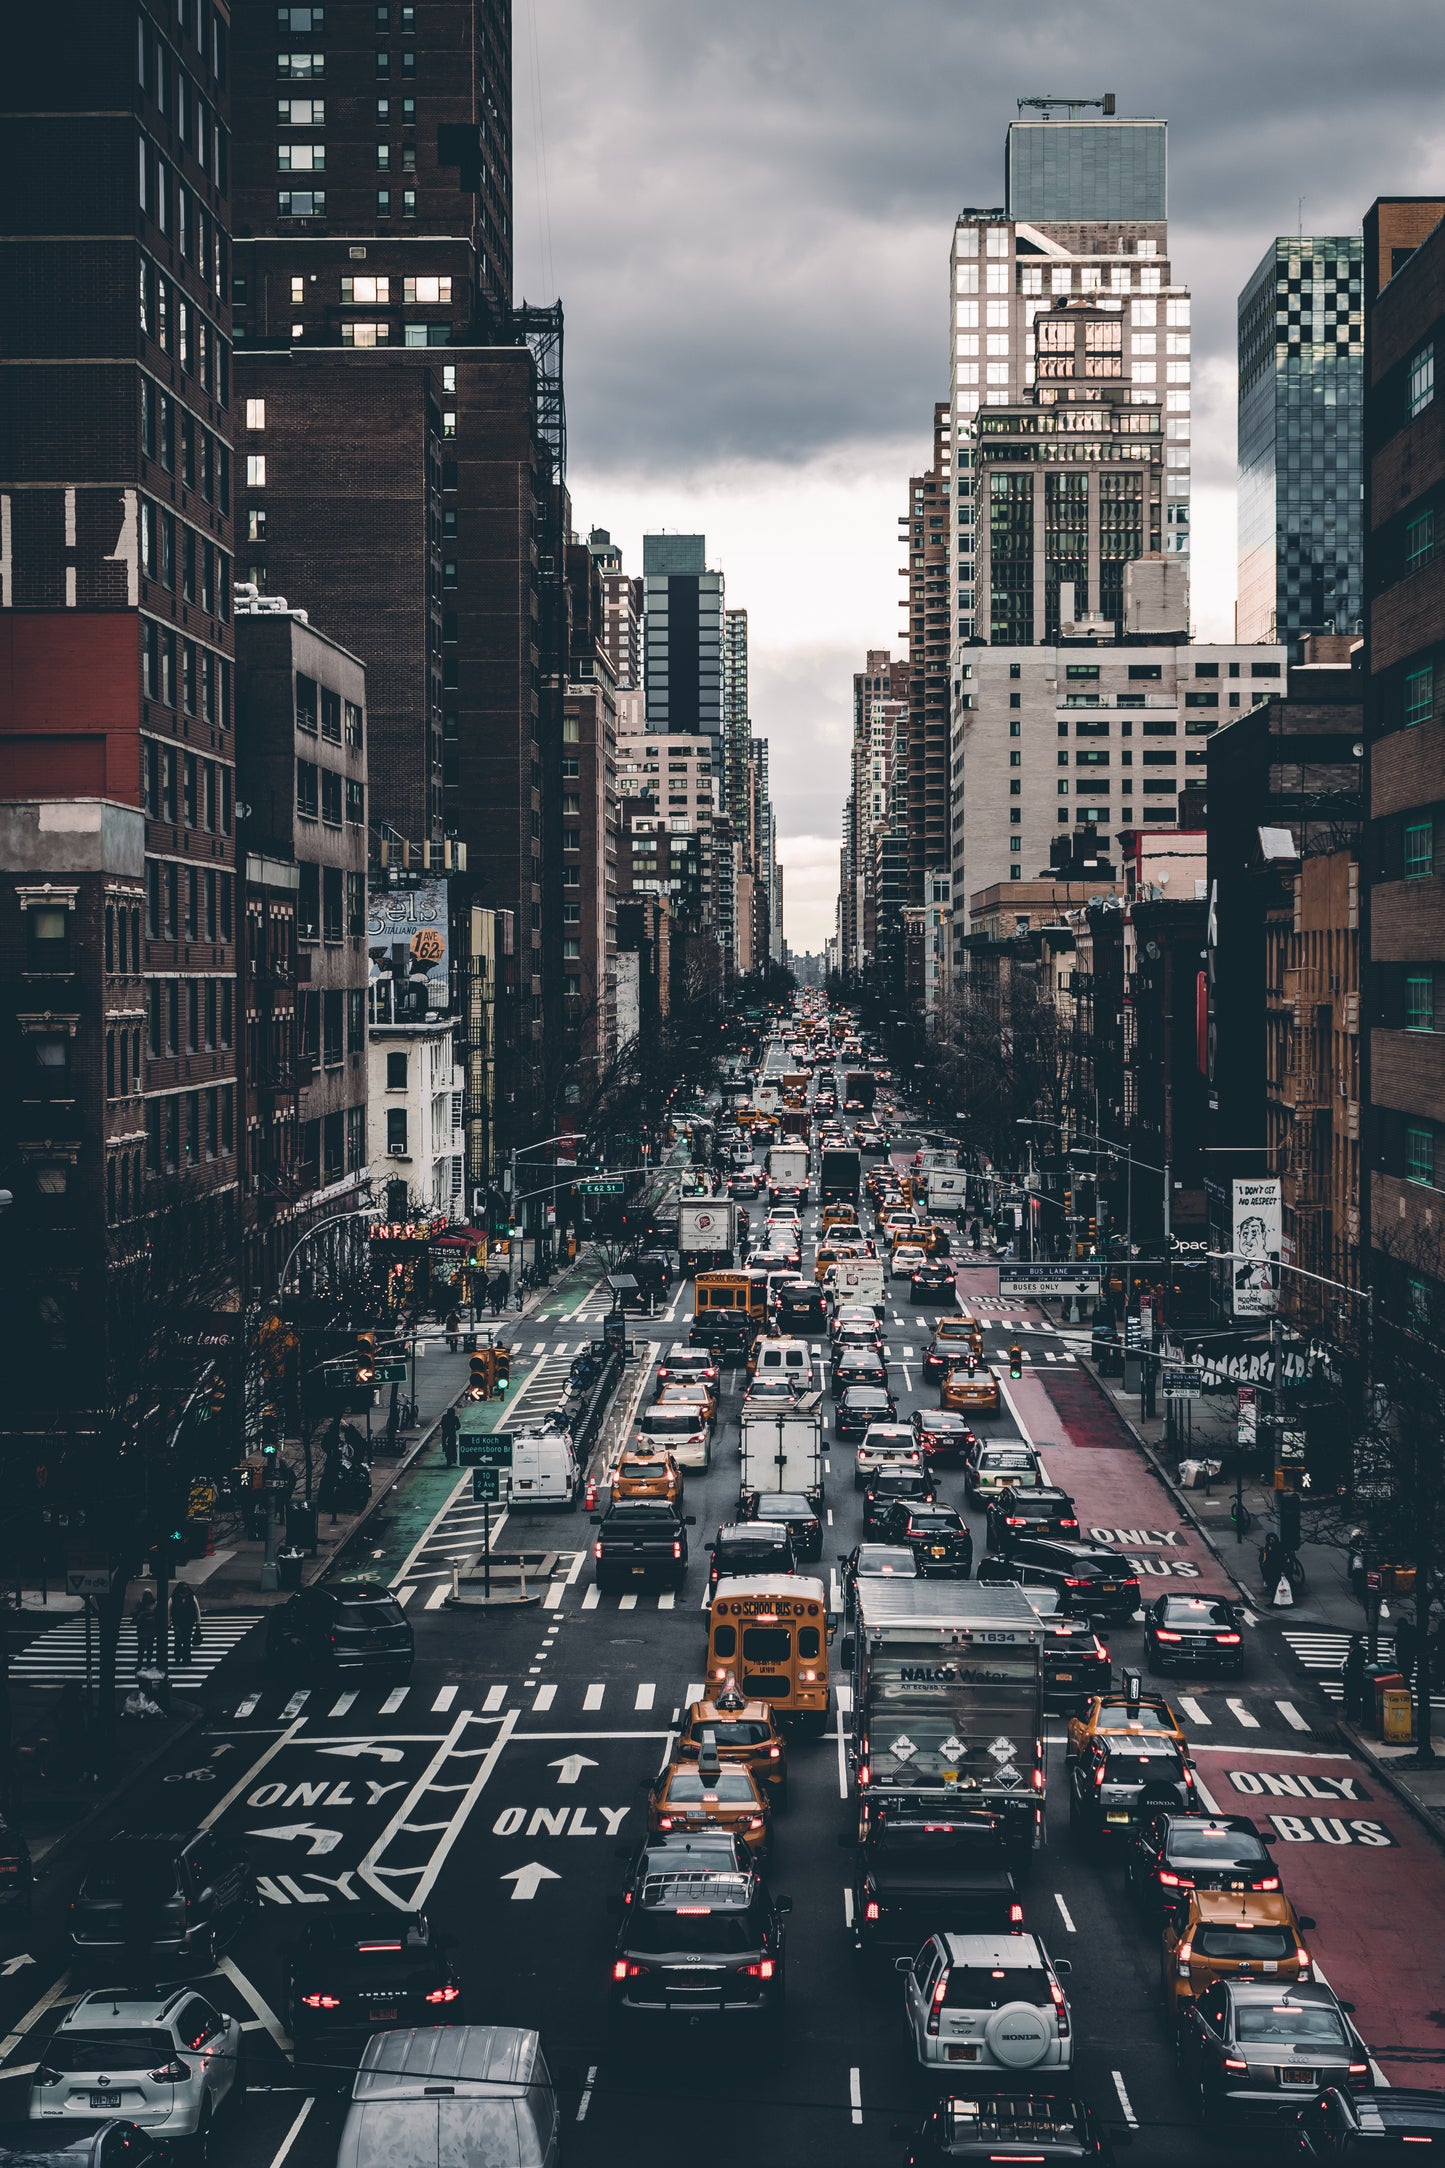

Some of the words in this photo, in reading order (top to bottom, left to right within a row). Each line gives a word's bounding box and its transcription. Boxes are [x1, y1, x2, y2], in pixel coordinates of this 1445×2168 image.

[384, 926, 417, 935] ITALIANO
[414, 931, 423, 953] 1
[423, 931, 439, 941] AVE
[420, 942, 439, 959] 62
[1245, 1185, 1263, 1195] DON'T
[1264, 1186, 1276, 1195] GET
[1238, 1198, 1249, 1206] NO
[1029, 1267, 1044, 1275] BUS
[1049, 1267, 1069, 1275] LANE
[969, 1296, 1026, 1304] ONLY
[979, 1304, 1028, 1312] BUS
[375, 1370, 390, 1380] St
[460, 1446, 502, 1454] Queensboro
[483, 1481, 496, 1489] Ave
[1090, 1528, 1180, 1546] ONLY
[1126, 1558, 1200, 1578] BUS
[743, 1601, 774, 1615] SCHOOL
[775, 1601, 791, 1616] BUS
[979, 1633, 1016, 1642] 1634
[900, 1668, 956, 1682] NALCO
[959, 1670, 1008, 1683] Water
[1229, 1772, 1360, 1800] ONLY
[246, 1780, 410, 1808] ONLY
[492, 1806, 631, 1837] ONLY
[1270, 1815, 1393, 1847] BUS
[256, 1870, 361, 1907] NLY
[1001, 2033, 1042, 2041] HONDA
